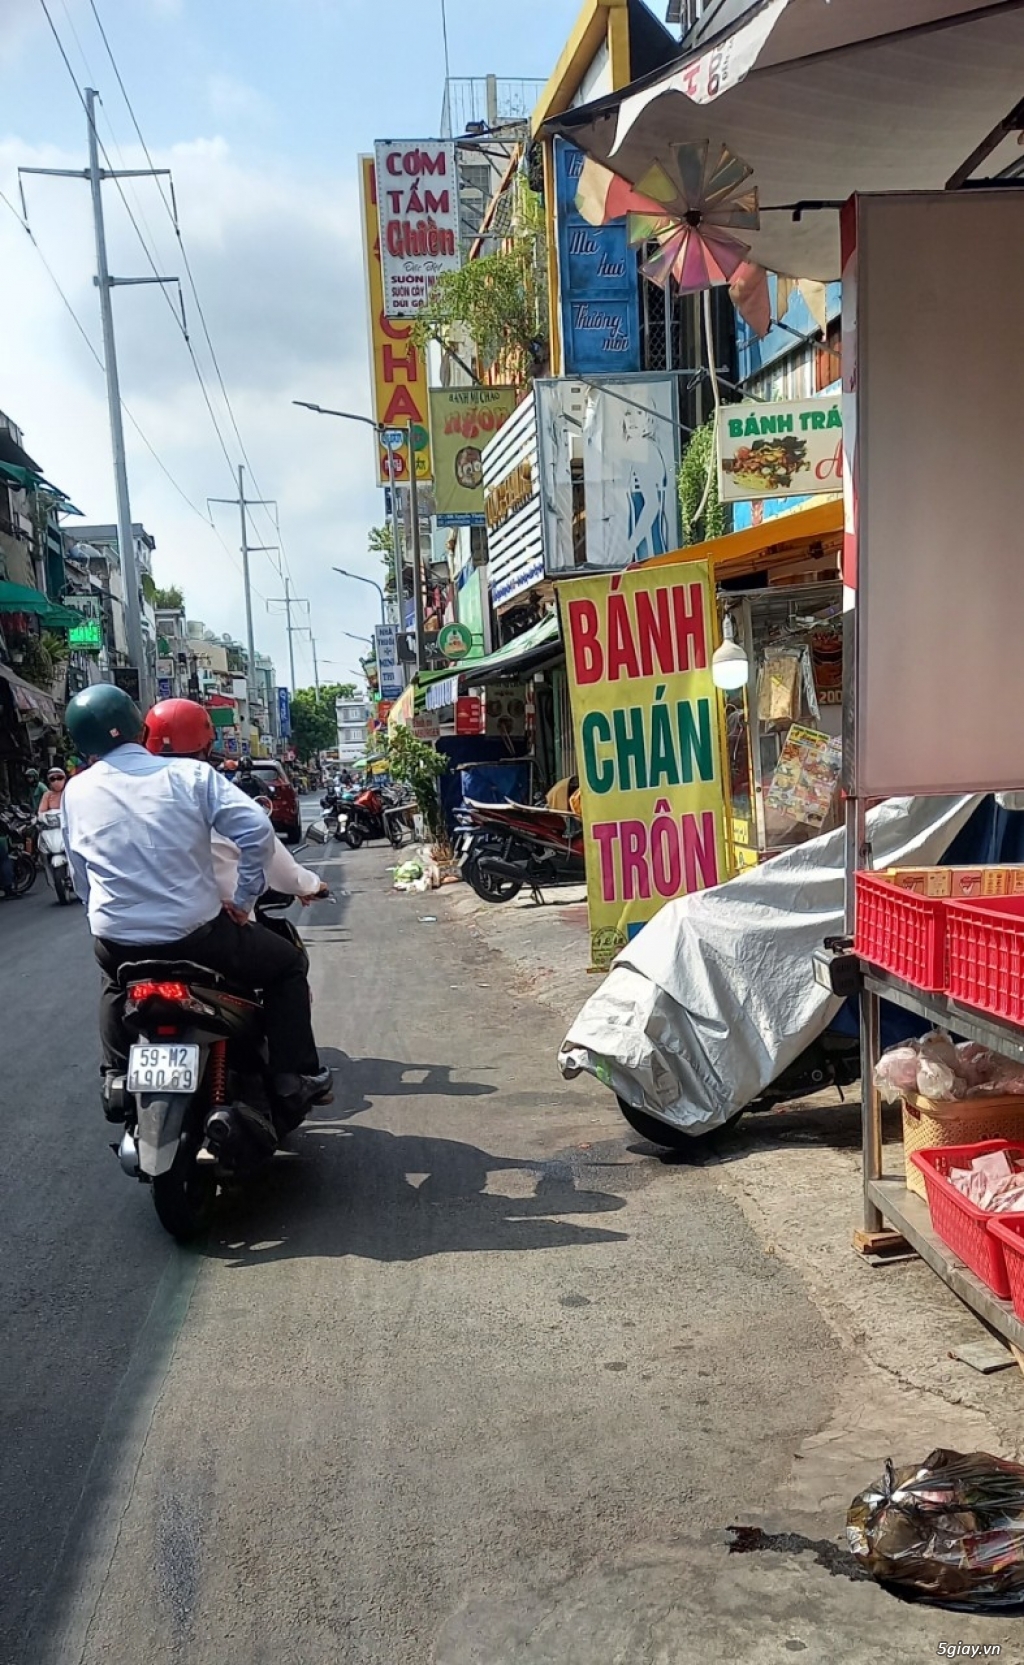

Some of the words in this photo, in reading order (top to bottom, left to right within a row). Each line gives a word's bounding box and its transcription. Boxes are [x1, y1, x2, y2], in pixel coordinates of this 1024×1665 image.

[386, 147, 446, 176] CƠM
[387, 177, 449, 214] TẤM
[728, 412, 793, 438] BÁNH
[567, 574, 708, 686] BÁNH
[581, 684, 715, 795] CHÁN
[593, 798, 719, 903] TRÔN
